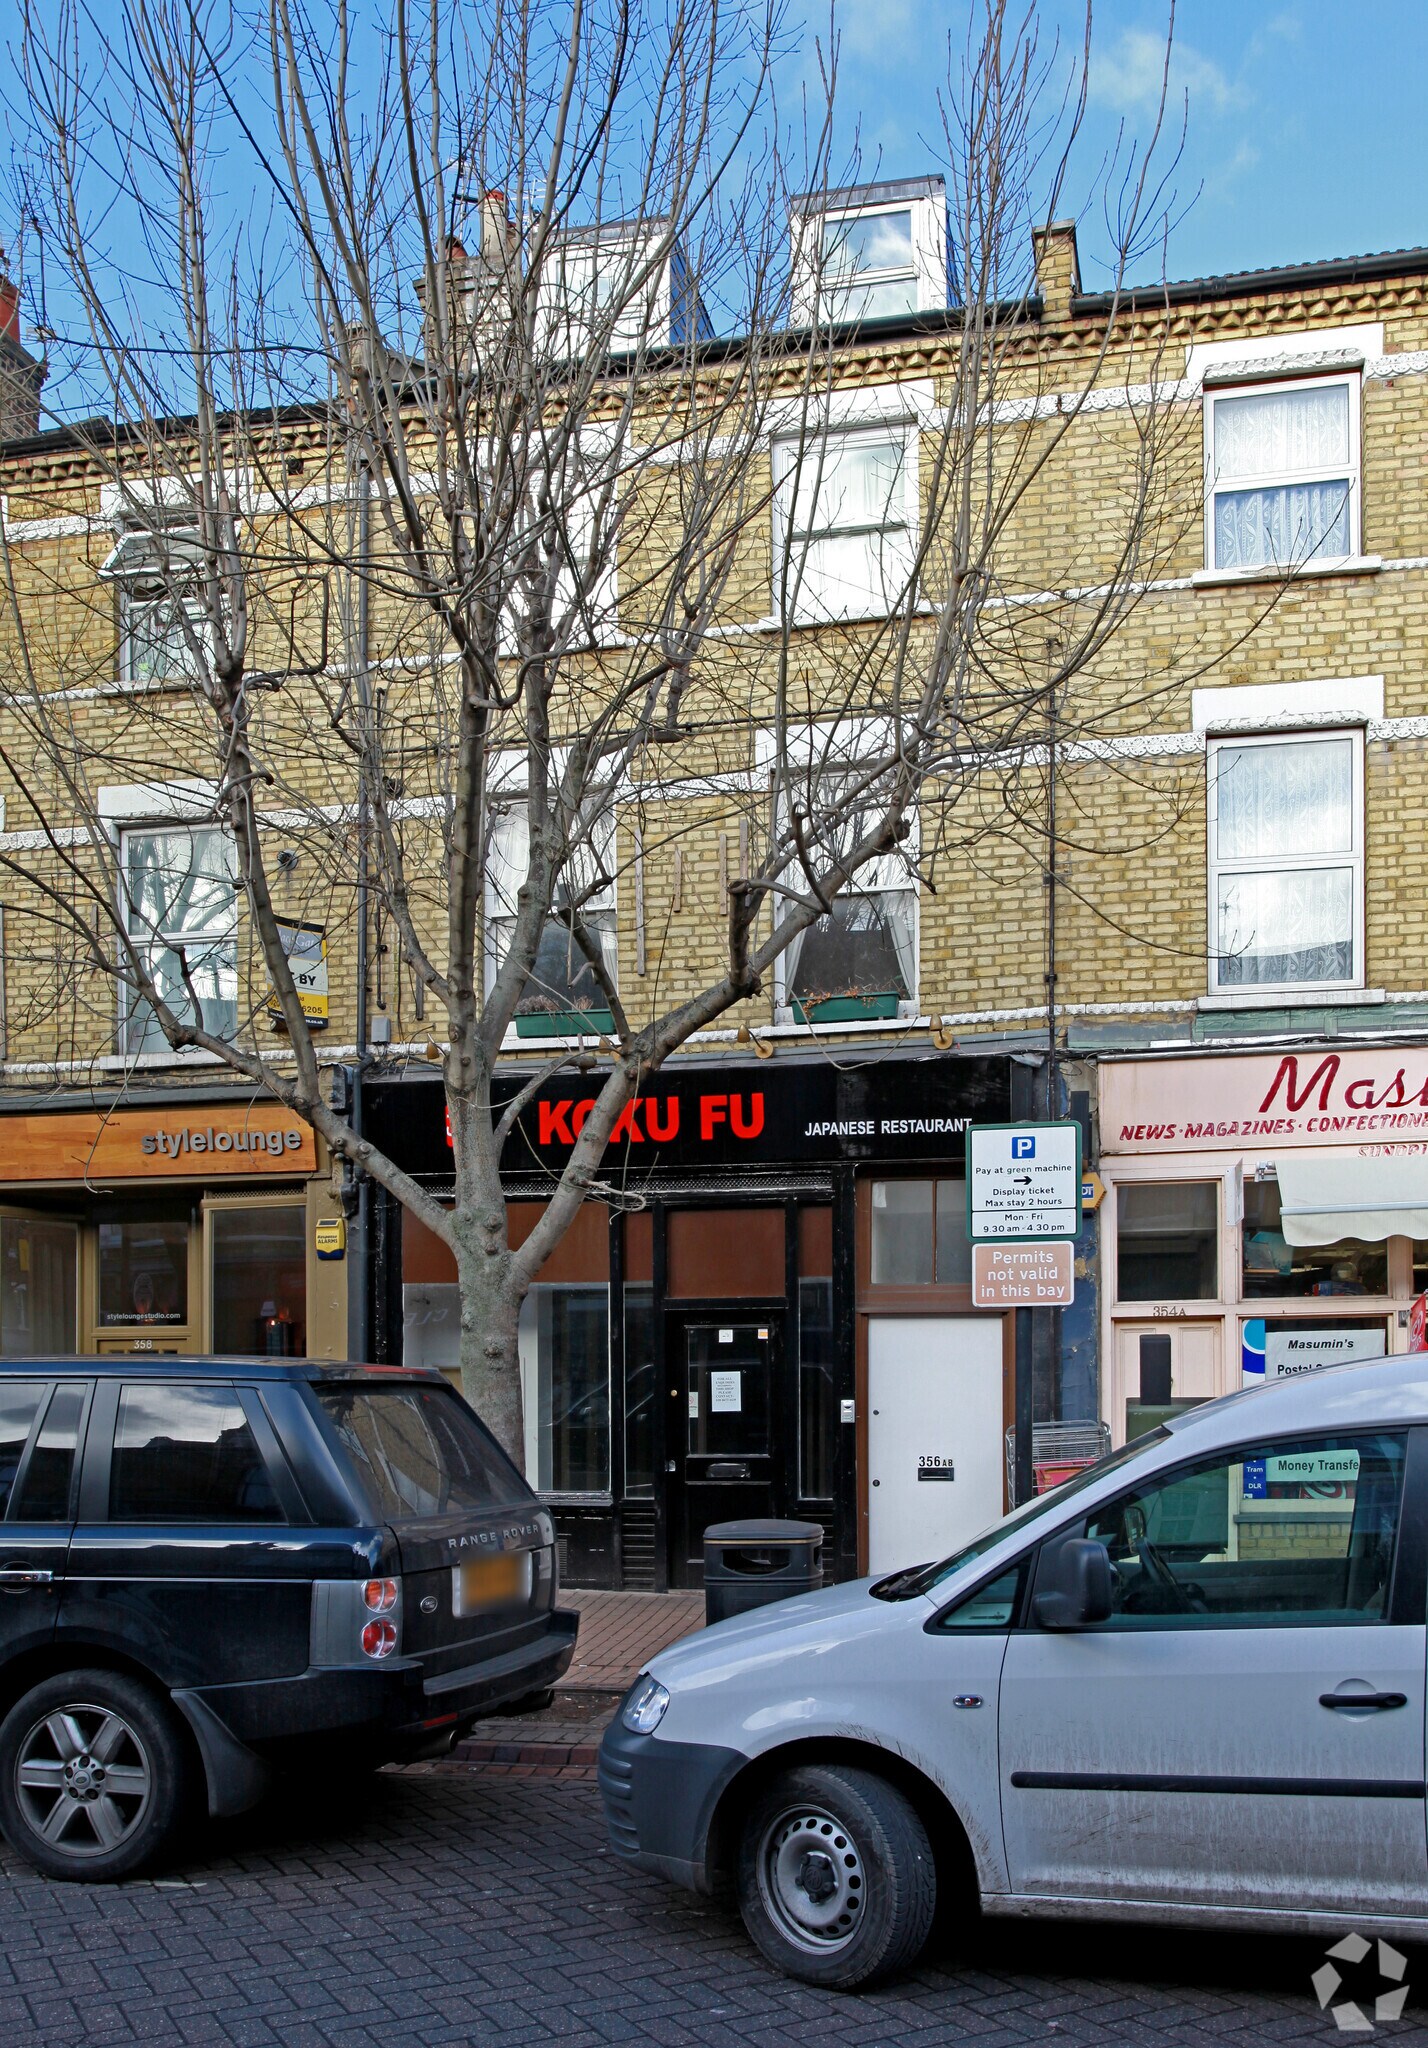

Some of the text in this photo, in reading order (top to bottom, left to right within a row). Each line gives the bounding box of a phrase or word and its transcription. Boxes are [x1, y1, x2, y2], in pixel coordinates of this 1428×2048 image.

[299, 973, 317, 986] BY
[700, 1092, 765, 1141] FU
[804, 1118, 973, 1136] JAPANESE RESTAURANT
[1119, 1123, 1177, 1141] NEWS
[1184, 1118, 1297, 1139] MAGAZINES
[140, 1127, 303, 1159] stylelounge
[1017, 1138, 1033, 1157] P
[975, 1167, 991, 1176] Pay
[1006, 1166, 1032, 1175] green
[1034, 1164, 1072, 1172] machine
[992, 1188, 1026, 1197] Display
[1082, 1186, 1093, 1195] DT
[1006, 1199, 1026, 1207] stay
[1028, 1198, 1035, 1206] 2
[983, 1225, 1005, 1233] 9.30
[1051, 1224, 1065, 1232] pm
[992, 1250, 1054, 1264] Permits
[987, 1266, 1058, 1281] not valid
[981, 1283, 1065, 1298] in this bay
[106, 1312, 181, 1321] styleloungestudio.com
[1153, 1305, 1187, 1317] 354A
[133, 1339, 153, 1349] 358
[1287, 1338, 1355, 1350] Masumin's
[1278, 1459, 1359, 1474] Money Transfe
[448, 1525, 539, 1548] RANGE ROVER
